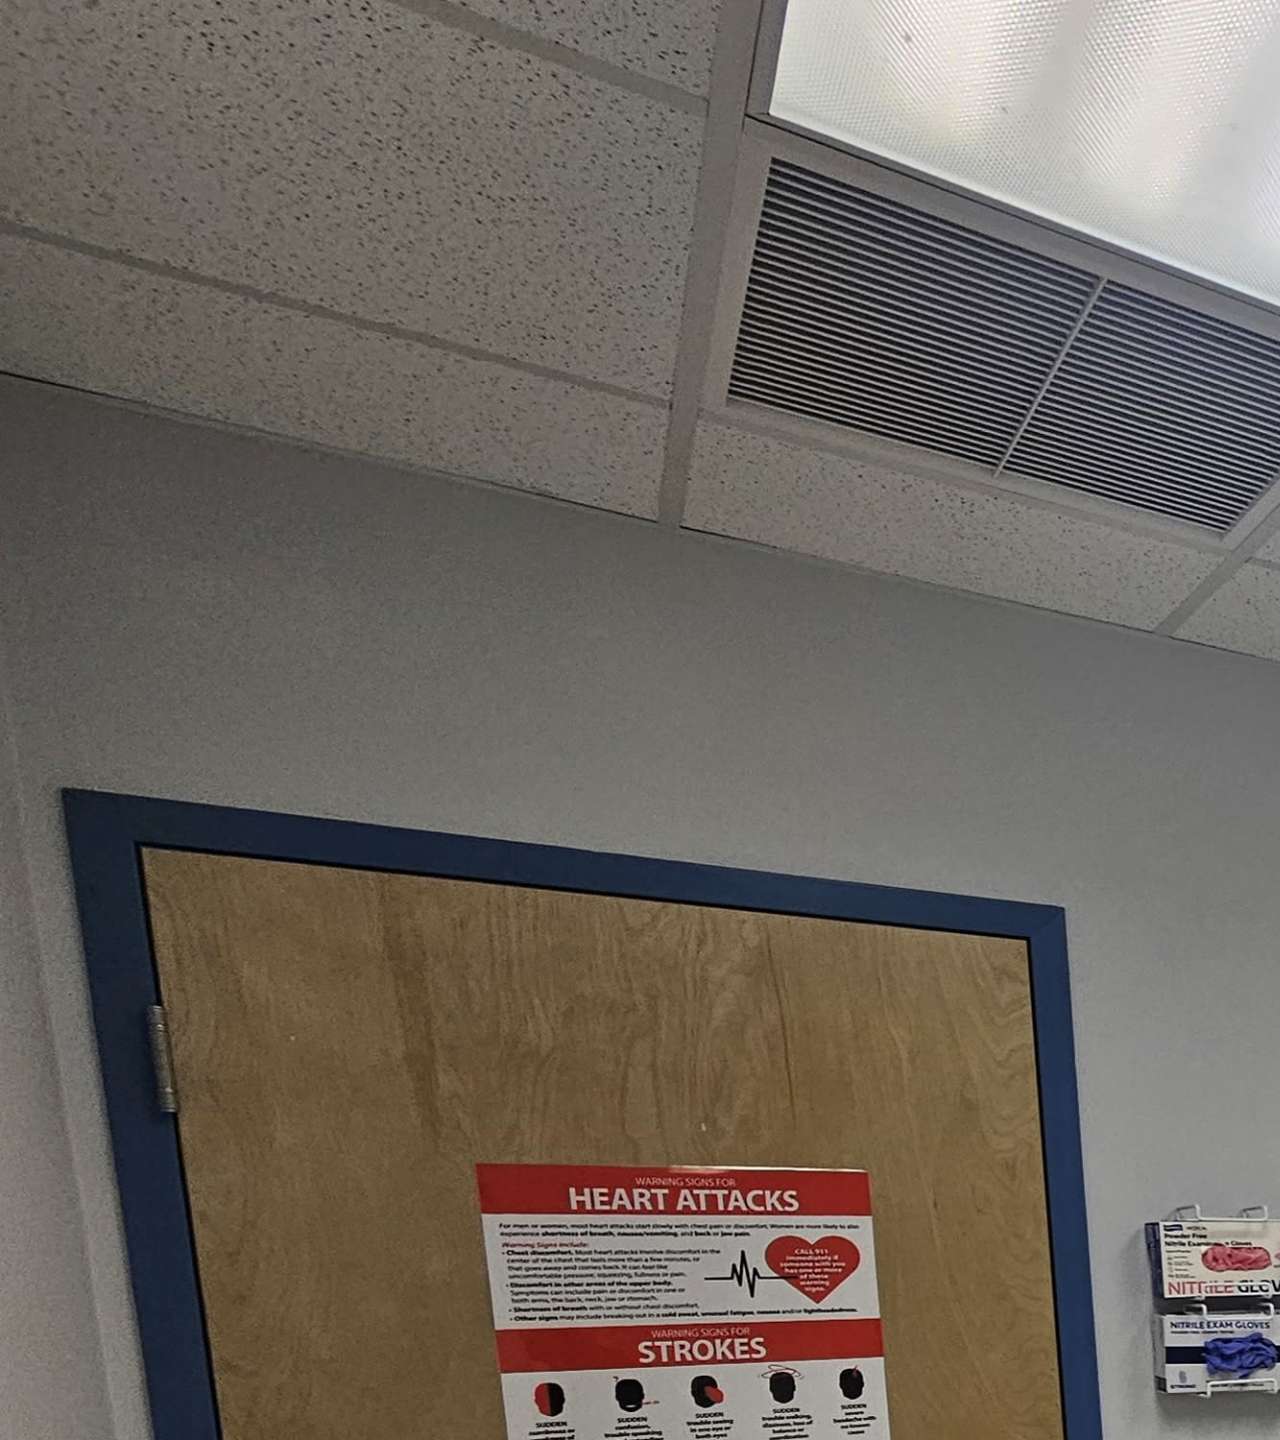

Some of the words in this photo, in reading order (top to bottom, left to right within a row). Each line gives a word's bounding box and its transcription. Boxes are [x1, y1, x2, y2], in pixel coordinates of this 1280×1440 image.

[635, 1177, 683, 1186] WARNING
[685, 1177, 714, 1187] SIGNS
[716, 1178, 736, 1187] FOR
[569, 1187, 668, 1211] HEART
[676, 1188, 800, 1213] ATTACKS
[1168, 1281, 1234, 1295] NITRILE
[1170, 1321, 1204, 1329] NITRILE
[1206, 1321, 1233, 1329] EXAM
[1235, 1321, 1270, 1329] GLOVES
[651, 1328, 699, 1338] WARNING
[701, 1328, 729, 1337] SIGNS
[731, 1326, 750, 1336] FOR
[638, 1337, 767, 1363] STROKES
